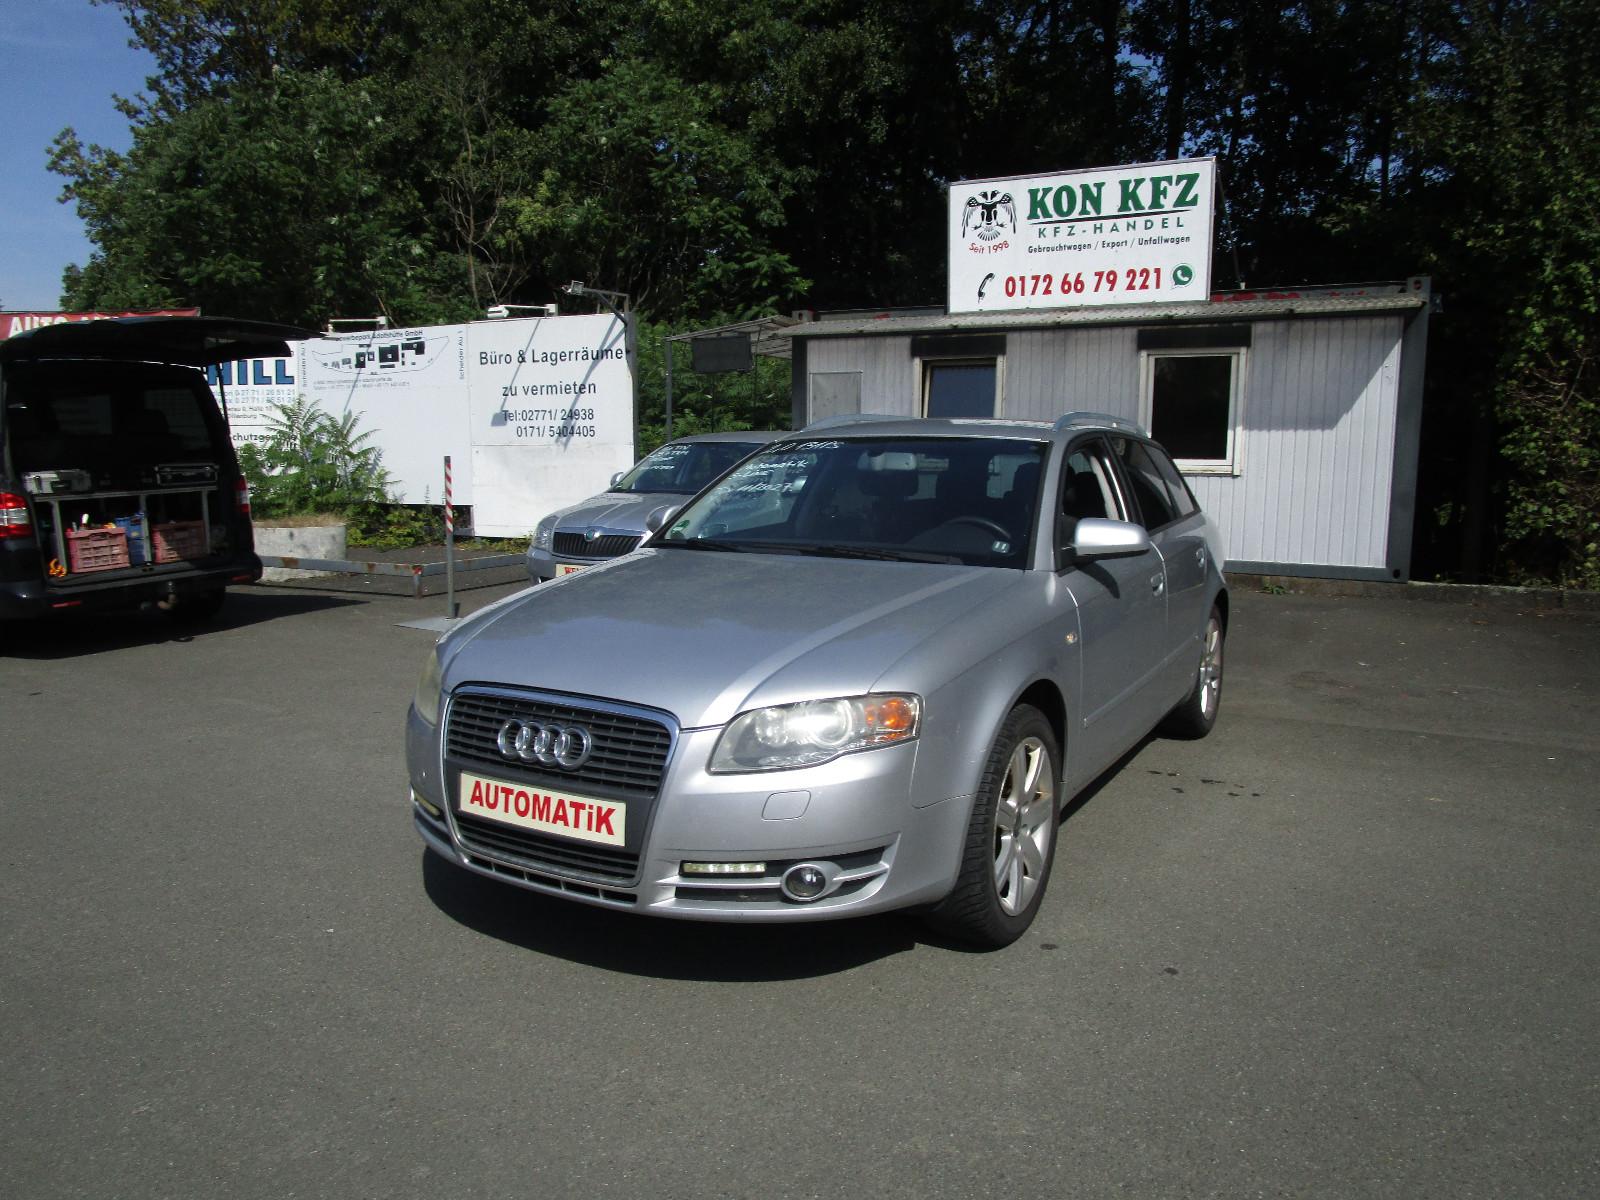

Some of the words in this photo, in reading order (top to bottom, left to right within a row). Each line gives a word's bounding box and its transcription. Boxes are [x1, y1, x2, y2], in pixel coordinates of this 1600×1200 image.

[1027, 182, 1106, 220] KON
[1117, 172, 1200, 213] KFZ
[1038, 216, 1185, 239] KFZ-HANDEL
[968, 242, 985, 254] Seit
[1027, 242, 1092, 254] Gebrauchtwagen
[1101, 239, 1129, 249] Export
[1138, 235, 1191, 246] Unfallwagen
[1005, 273, 1053, 298] 0172
[1060, 272, 1085, 295] 66
[1093, 270, 1118, 293] 79
[1125, 268, 1161, 292] 221
[479, 350, 513, 366] Büro
[517, 349, 527, 364] &
[532, 346, 624, 366] Lagerräume
[502, 385, 518, 397] zu
[523, 381, 597, 396] vermieten
[560, 408, 595, 421] 24938
[516, 426, 546, 438] 0171/
[549, 425, 596, 438] 5404405
